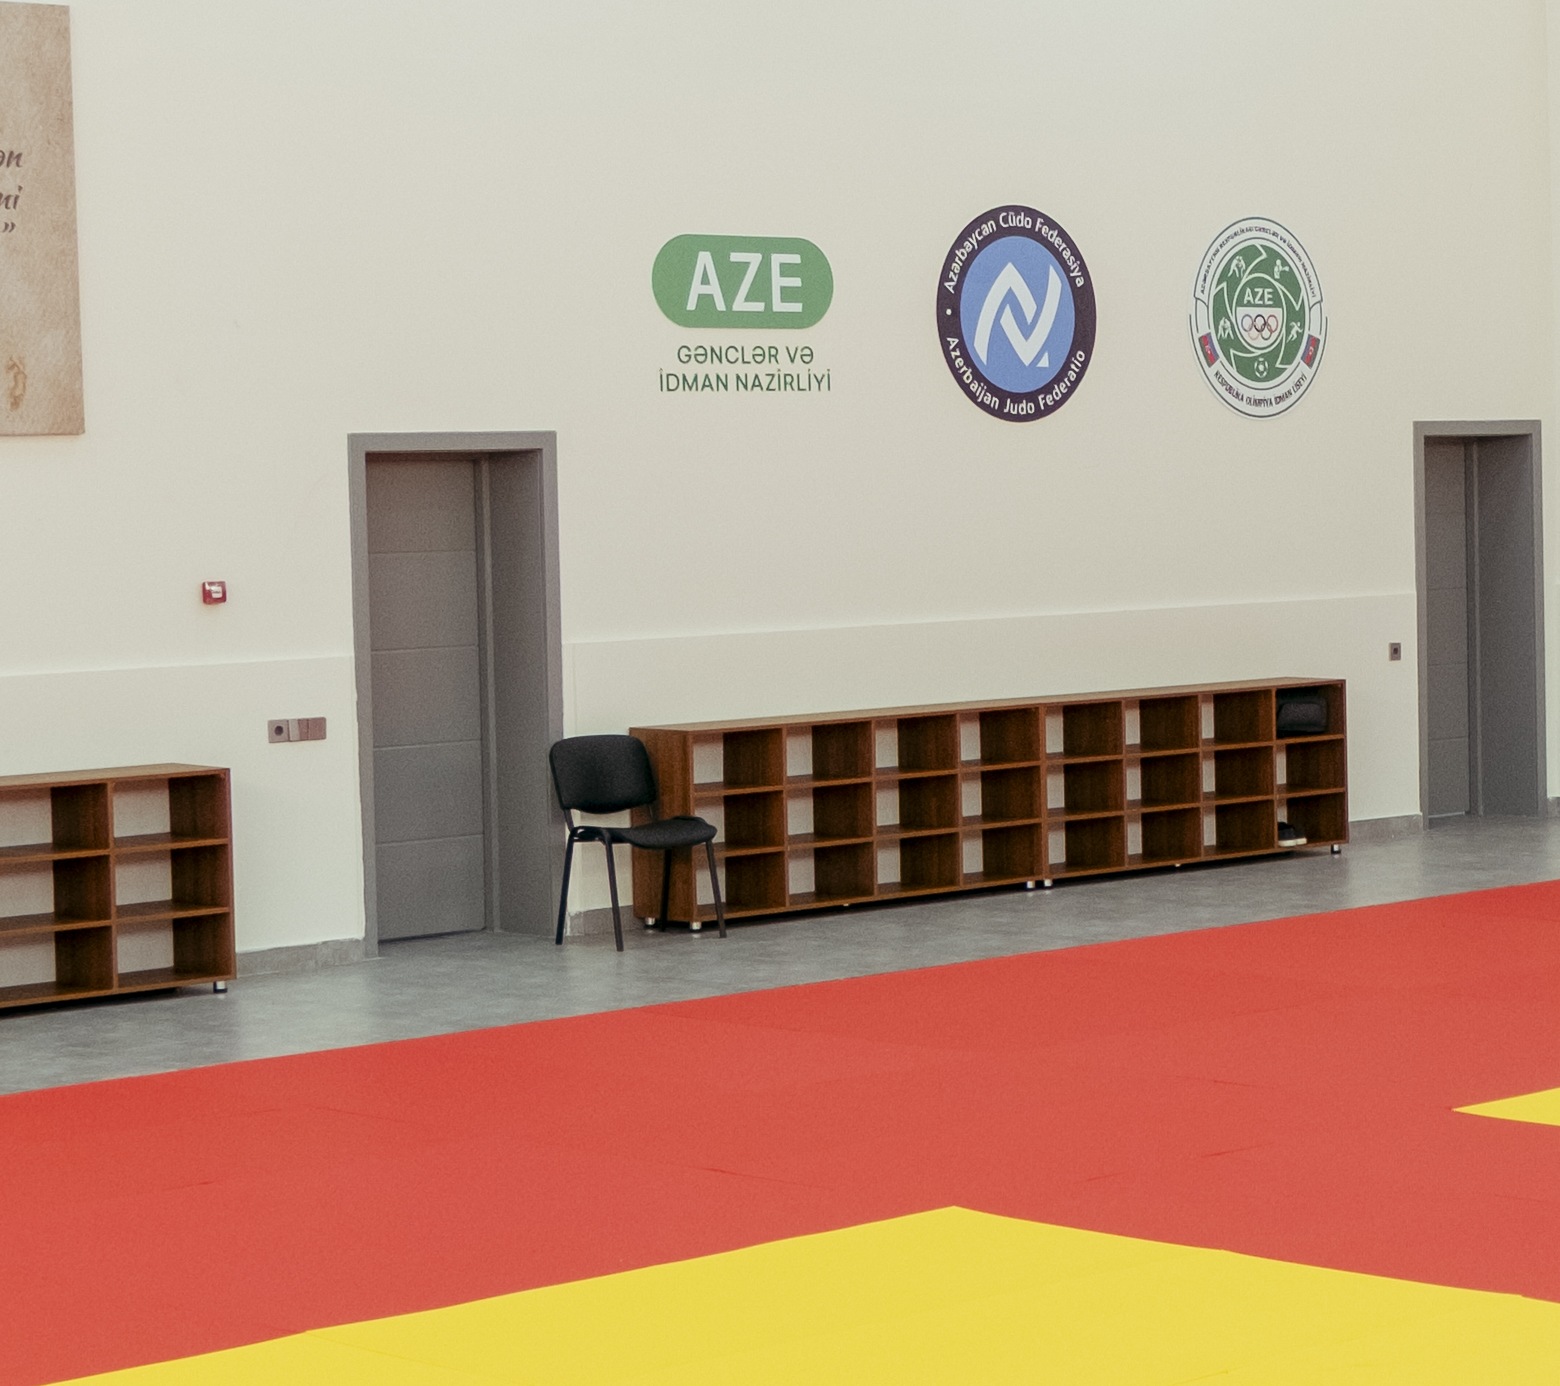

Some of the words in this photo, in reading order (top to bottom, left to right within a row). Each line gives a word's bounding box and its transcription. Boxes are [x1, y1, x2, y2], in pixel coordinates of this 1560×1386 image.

[999, 210, 1033, 229] Cüdo
[685, 250, 804, 313] AZE
[1243, 287, 1274, 305] AZE
[676, 344, 779, 365] GƏNCLƏR
[785, 345, 815, 365] VƏ
[658, 367, 729, 392] İDMAN
[735, 368, 832, 392] NAZİRLİYİ
[946, 336, 1000, 410] Azerbaijan
[1003, 398, 1035, 415] Judo
